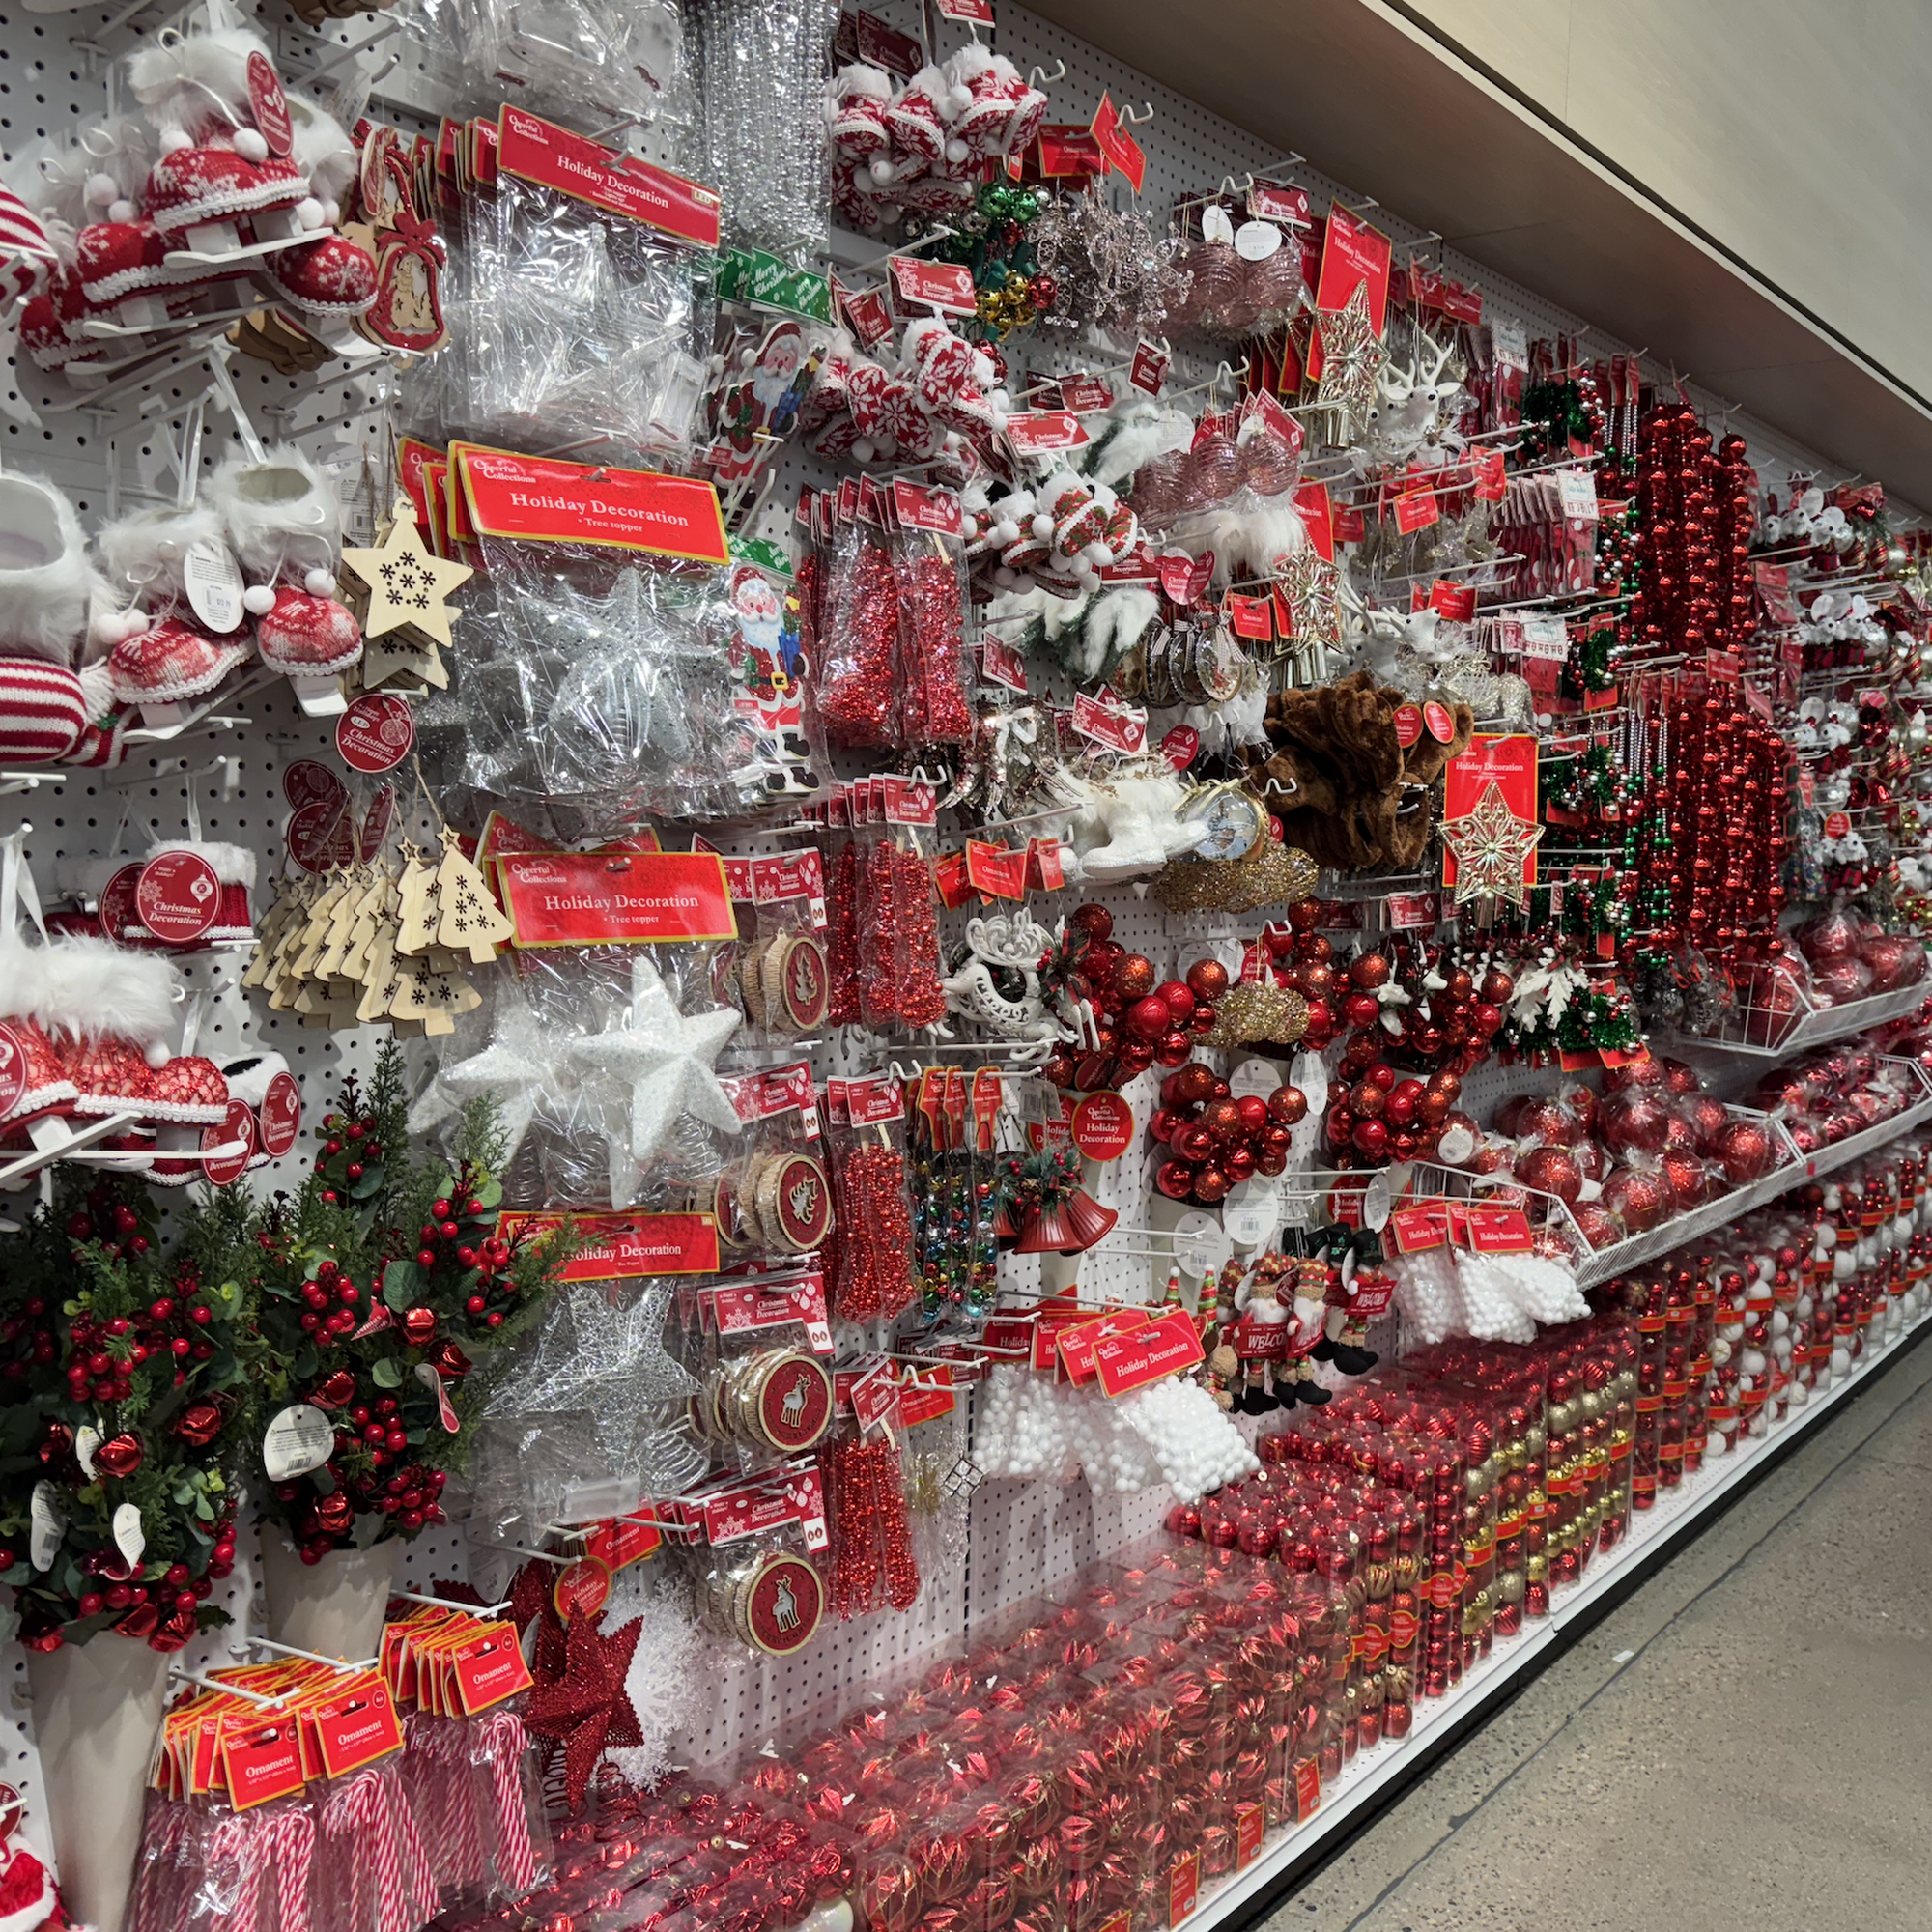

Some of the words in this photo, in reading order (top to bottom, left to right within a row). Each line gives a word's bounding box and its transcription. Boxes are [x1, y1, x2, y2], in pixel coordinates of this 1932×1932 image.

[557, 155, 604, 185] Holiday
[608, 174, 668, 208] Decoration
[694, 191, 712, 204] LED
[473, 459, 517, 474] Cheerful
[483, 469, 536, 483] Collections
[510, 493, 586, 515] Holiday
[590, 499, 689, 526] Decoration
[584, 518, 609, 528] Tree
[610, 522, 643, 532] topper
[353, 718, 369, 727] LED
[350, 728, 395, 754] Christmas
[341, 737, 391, 764] Decoration
[1456, 762, 1483, 772] Holiday
[1484, 762, 1523, 771] Decoration
[520, 872, 567, 883] Collections
[153, 901, 202, 915] Christmas
[545, 895, 611, 911] Holiday
[615, 894, 699, 908] Decoration
[149, 912, 202, 925] Decoration
[610, 915, 630, 923] Tree
[631, 915, 660, 924] topper
[1087, 1123, 1120, 1134] Holiday
[1080, 1134, 1125, 1144] Decoration
[1408, 1230, 1430, 1240] Holiday
[1480, 1233, 1499, 1242] Holiday
[620, 1242, 681, 1258] Decoration
[757, 1298, 787, 1310] Christmas
[1357, 1292, 1387, 1306] WELCOME
[756, 1307, 789, 1319] Decoration
[1248, 1332, 1287, 1349] WELCO
[1116, 1359, 1148, 1378] Holiday
[1148, 1342, 1189, 1364] Decoration
[901, 1393, 931, 1408] Ornament
[752, 1498, 784, 1513] Christmas
[751, 1508, 786, 1523] Decoration
[606, 1526, 639, 1550] Ornament
[473, 1662, 512, 1684] Ornament
[338, 1720, 383, 1746] Ornament
[245, 1755, 294, 1777] Ornament
